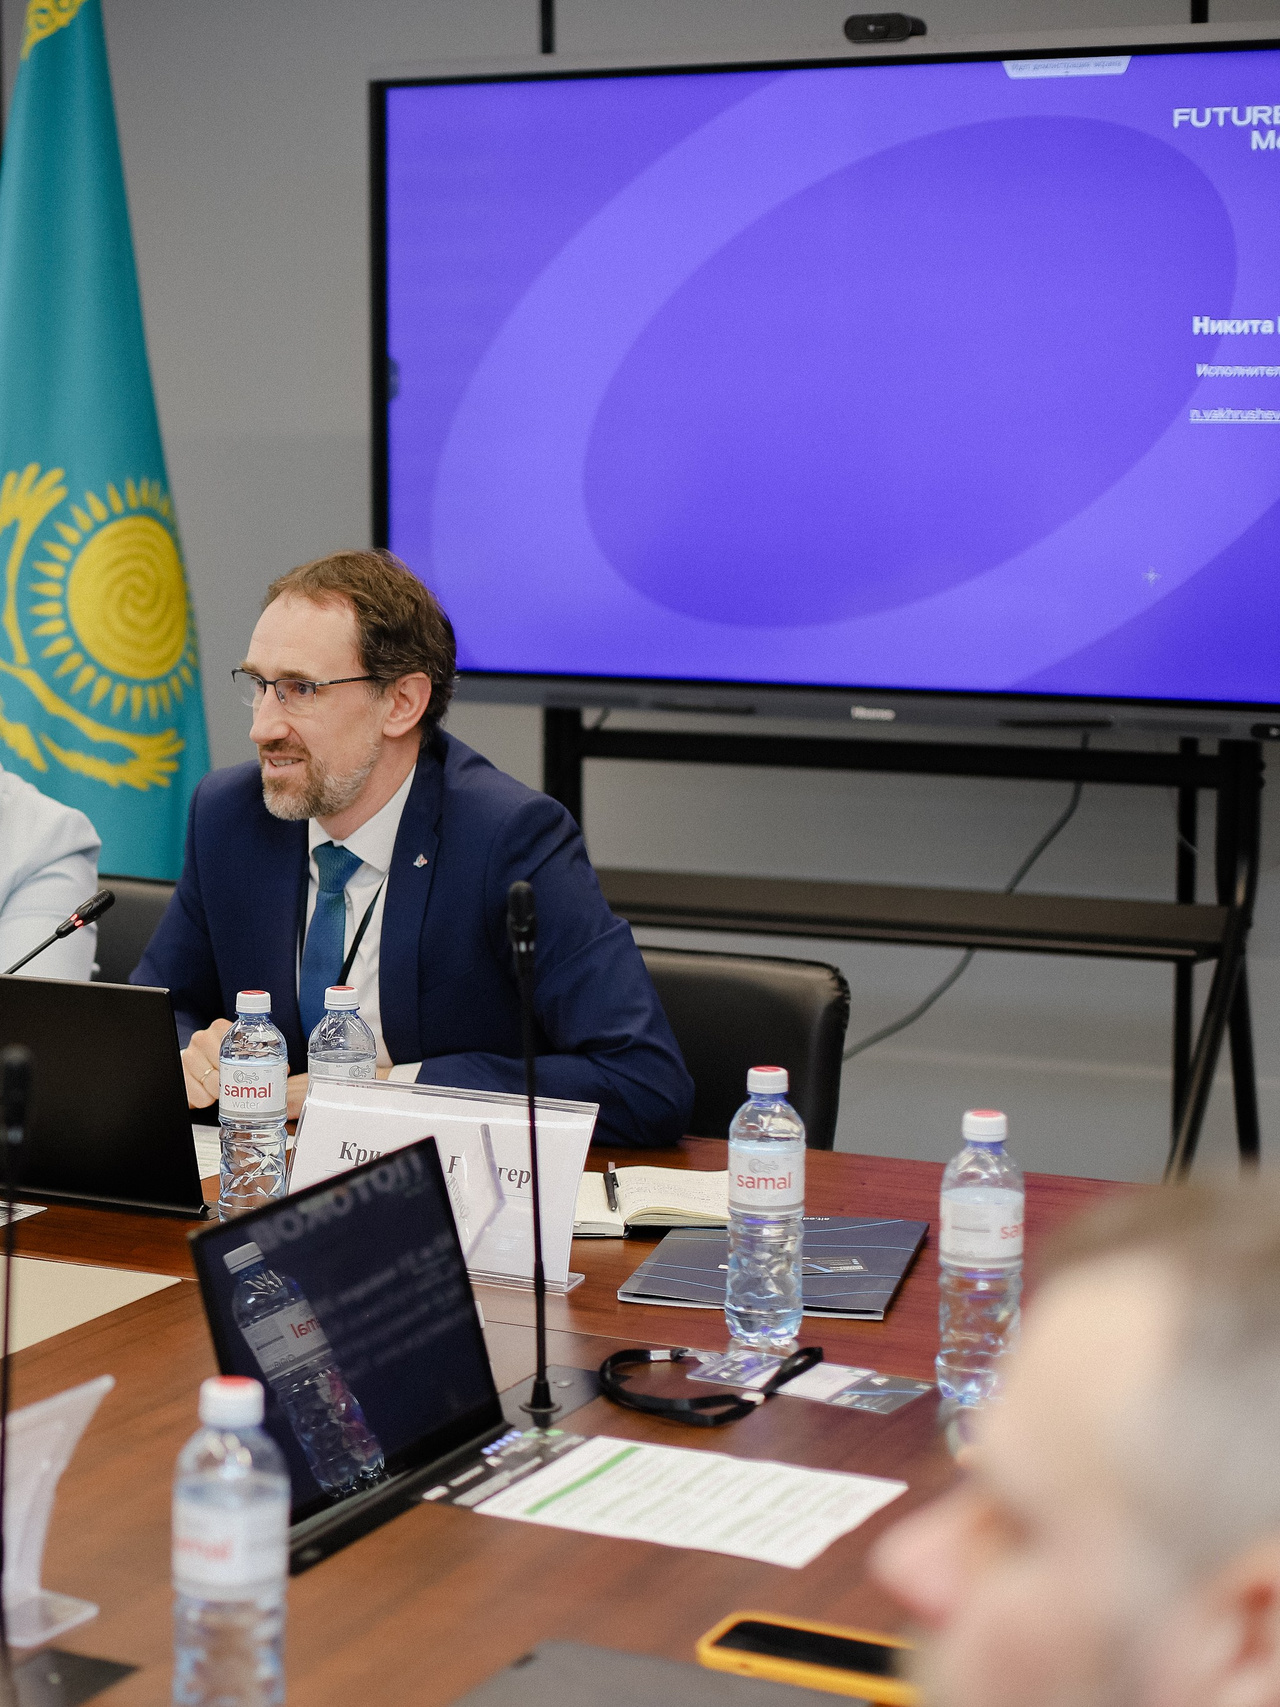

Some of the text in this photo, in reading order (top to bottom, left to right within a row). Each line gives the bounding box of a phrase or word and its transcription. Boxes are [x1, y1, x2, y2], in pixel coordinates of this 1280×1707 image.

[1173, 105, 1280, 129] FUTURE
[1192, 315, 1275, 335] Никита
[224, 1082, 272, 1099] samal
[232, 1100, 260, 1110] water
[736, 1172, 792, 1190] samal
